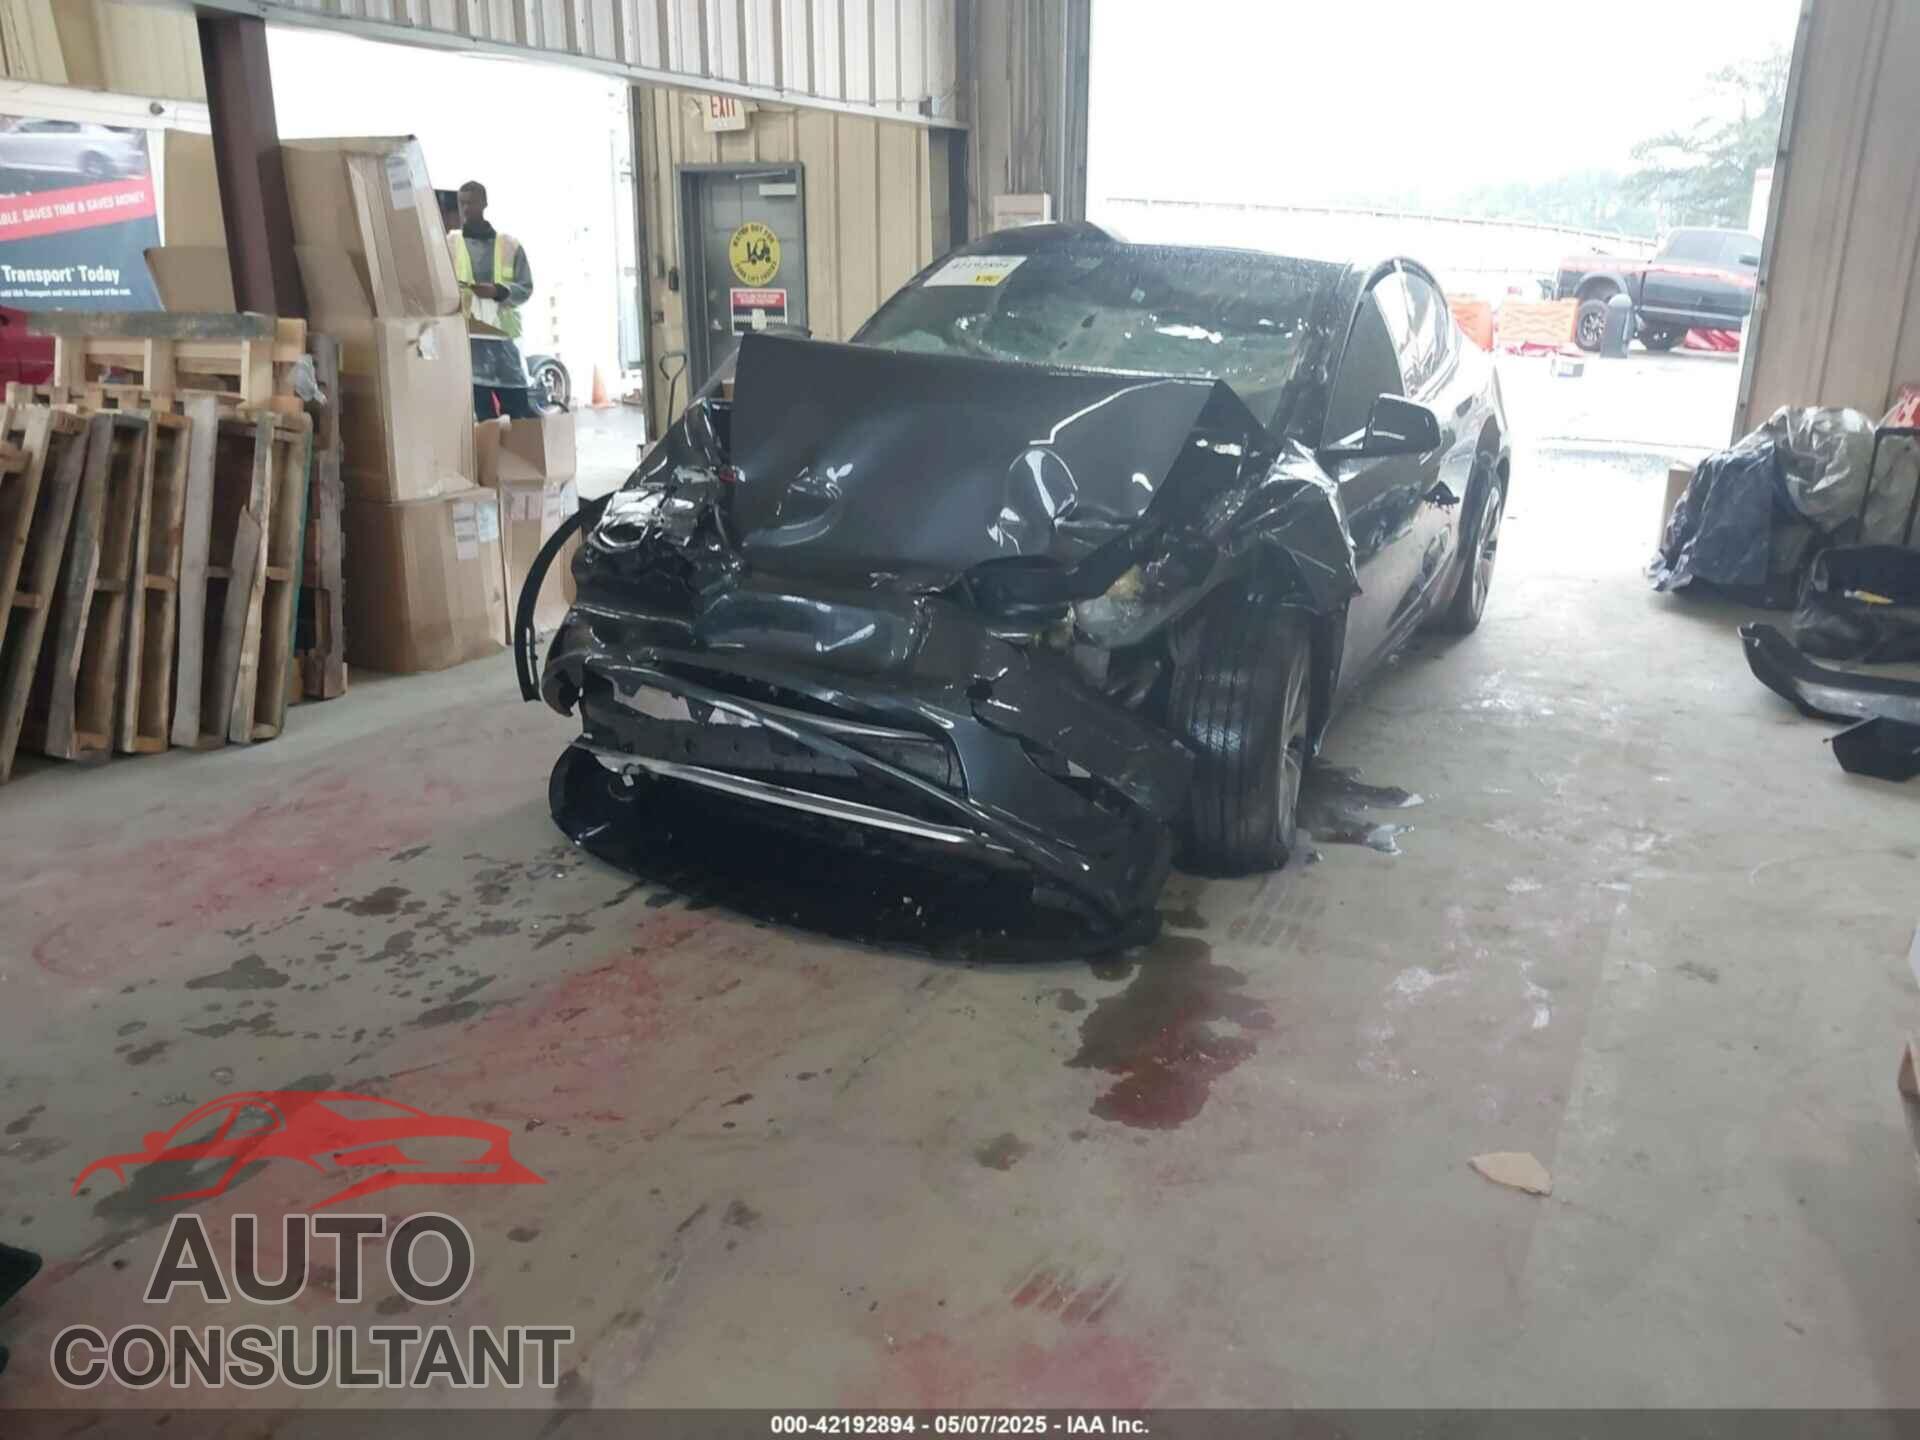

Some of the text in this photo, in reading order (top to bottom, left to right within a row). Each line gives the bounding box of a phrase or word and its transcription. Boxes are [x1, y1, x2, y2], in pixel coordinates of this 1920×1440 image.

[710, 95, 736, 118] EXIT
[1, 265, 120, 286] Transport Today
